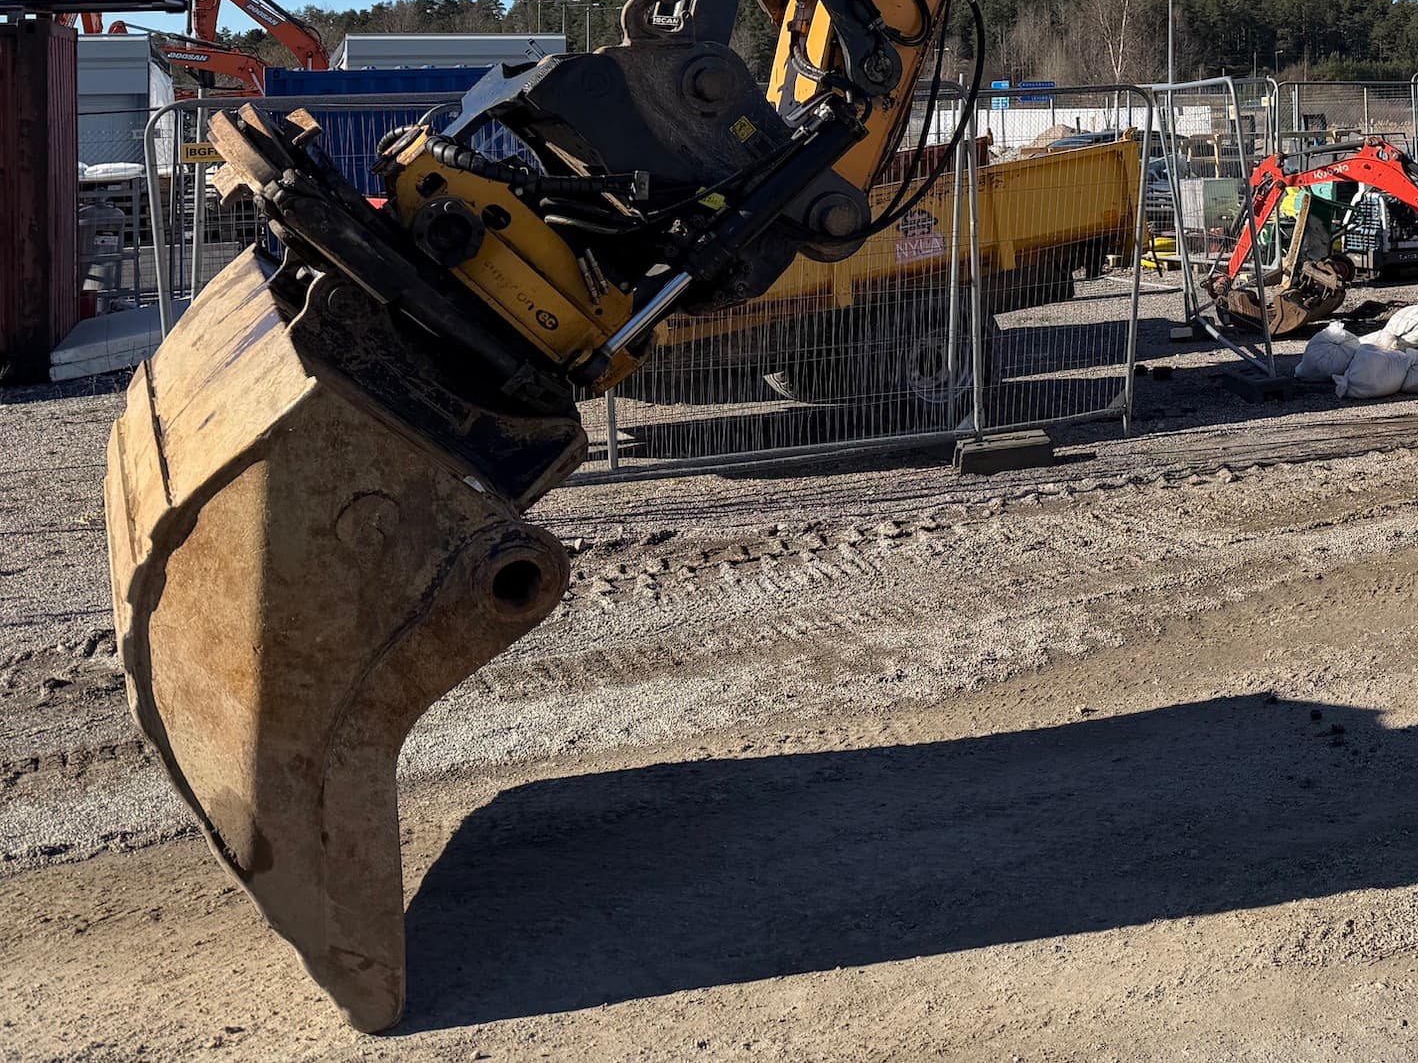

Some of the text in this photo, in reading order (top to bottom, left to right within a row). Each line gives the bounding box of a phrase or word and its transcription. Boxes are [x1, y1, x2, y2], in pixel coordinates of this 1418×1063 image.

[247, 3, 279, 26] DOOSAN
[168, 52, 208, 62] DOOSAN
[1314, 164, 1349, 179] Kubota
